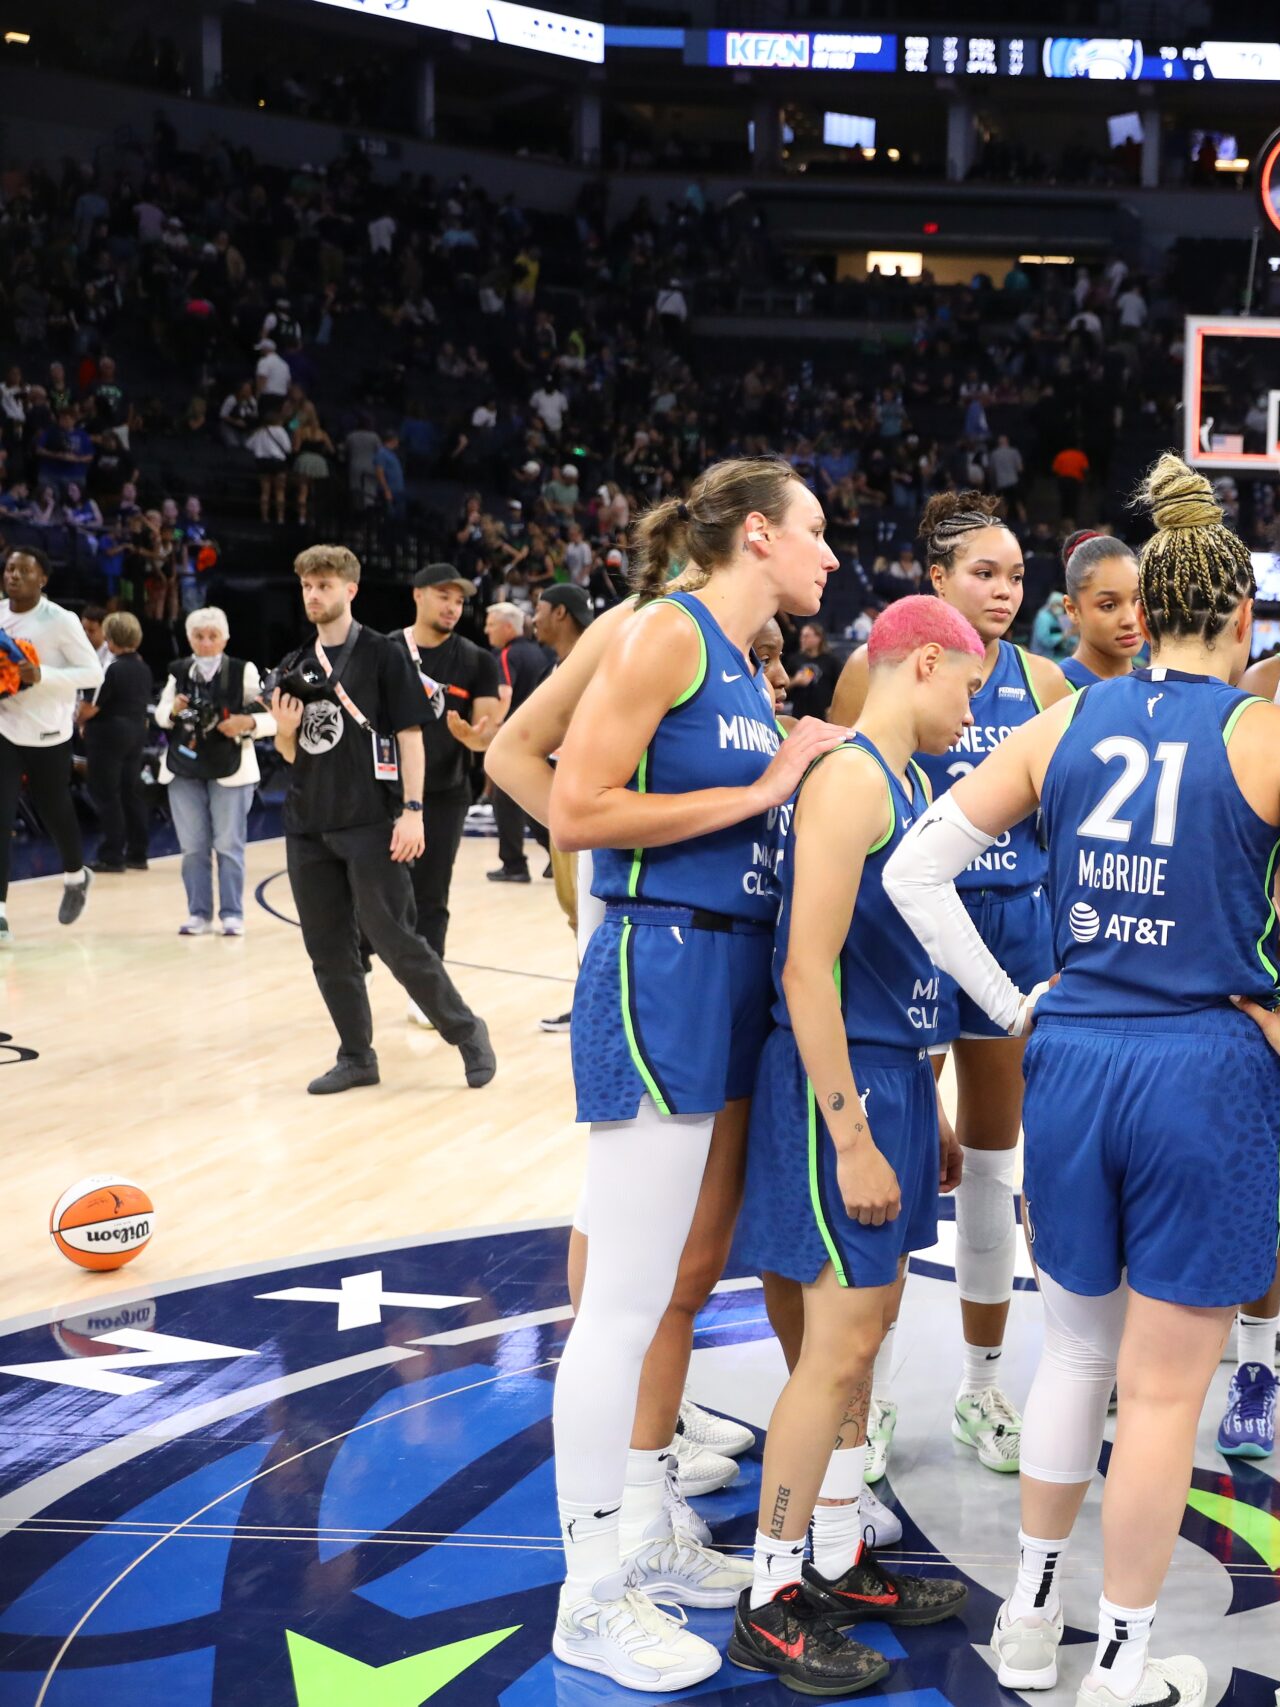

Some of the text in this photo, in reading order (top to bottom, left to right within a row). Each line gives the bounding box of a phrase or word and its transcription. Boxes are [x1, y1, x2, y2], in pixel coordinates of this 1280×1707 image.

[728, 34, 809, 67] KFAN
[1076, 735, 1189, 846] 21
[1078, 849, 1168, 896] McBRIDE
[1104, 914, 1176, 946] AT&T
[87, 1220, 150, 1244] Wilson
[769, 1484, 791, 1540] BELIEV
